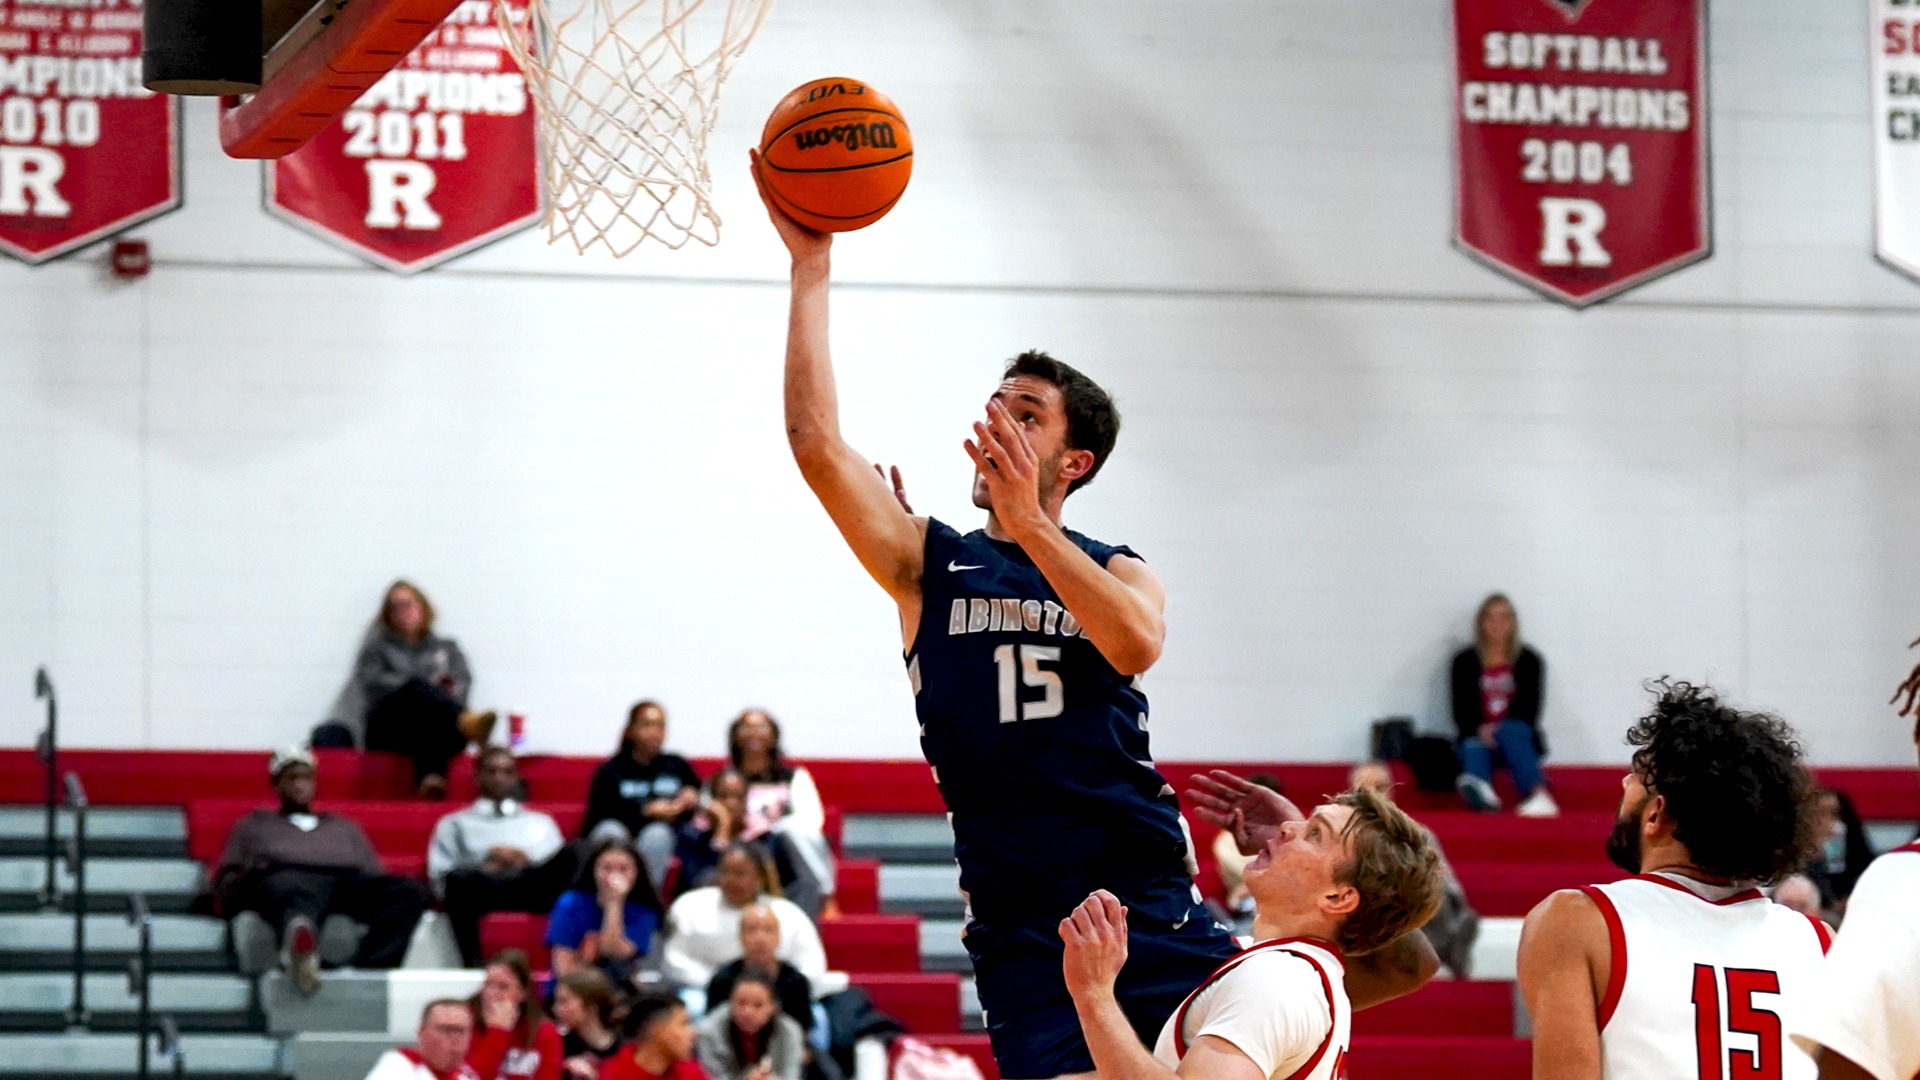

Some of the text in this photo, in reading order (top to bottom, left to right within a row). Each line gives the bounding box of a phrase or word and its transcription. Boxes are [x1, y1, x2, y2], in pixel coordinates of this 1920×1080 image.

[1483, 31, 1668, 74] SOFTBALL
[351, 69, 526, 116] MPIONS
[808, 83, 865, 102] EVO
[1463, 81, 1689, 131] CHAMPIONS
[0, 96, 100, 148] 010
[342, 109, 467, 160] 2011
[795, 122, 897, 151] Wilson
[0, 146, 71, 217] R
[1520, 137, 1633, 186] 2004
[364, 160, 442, 230] R
[1539, 197, 1612, 268] R
[948, 598, 1090, 639] ABINGTO
[993, 644, 1064, 724] 15
[1691, 963, 1783, 1080] 15
